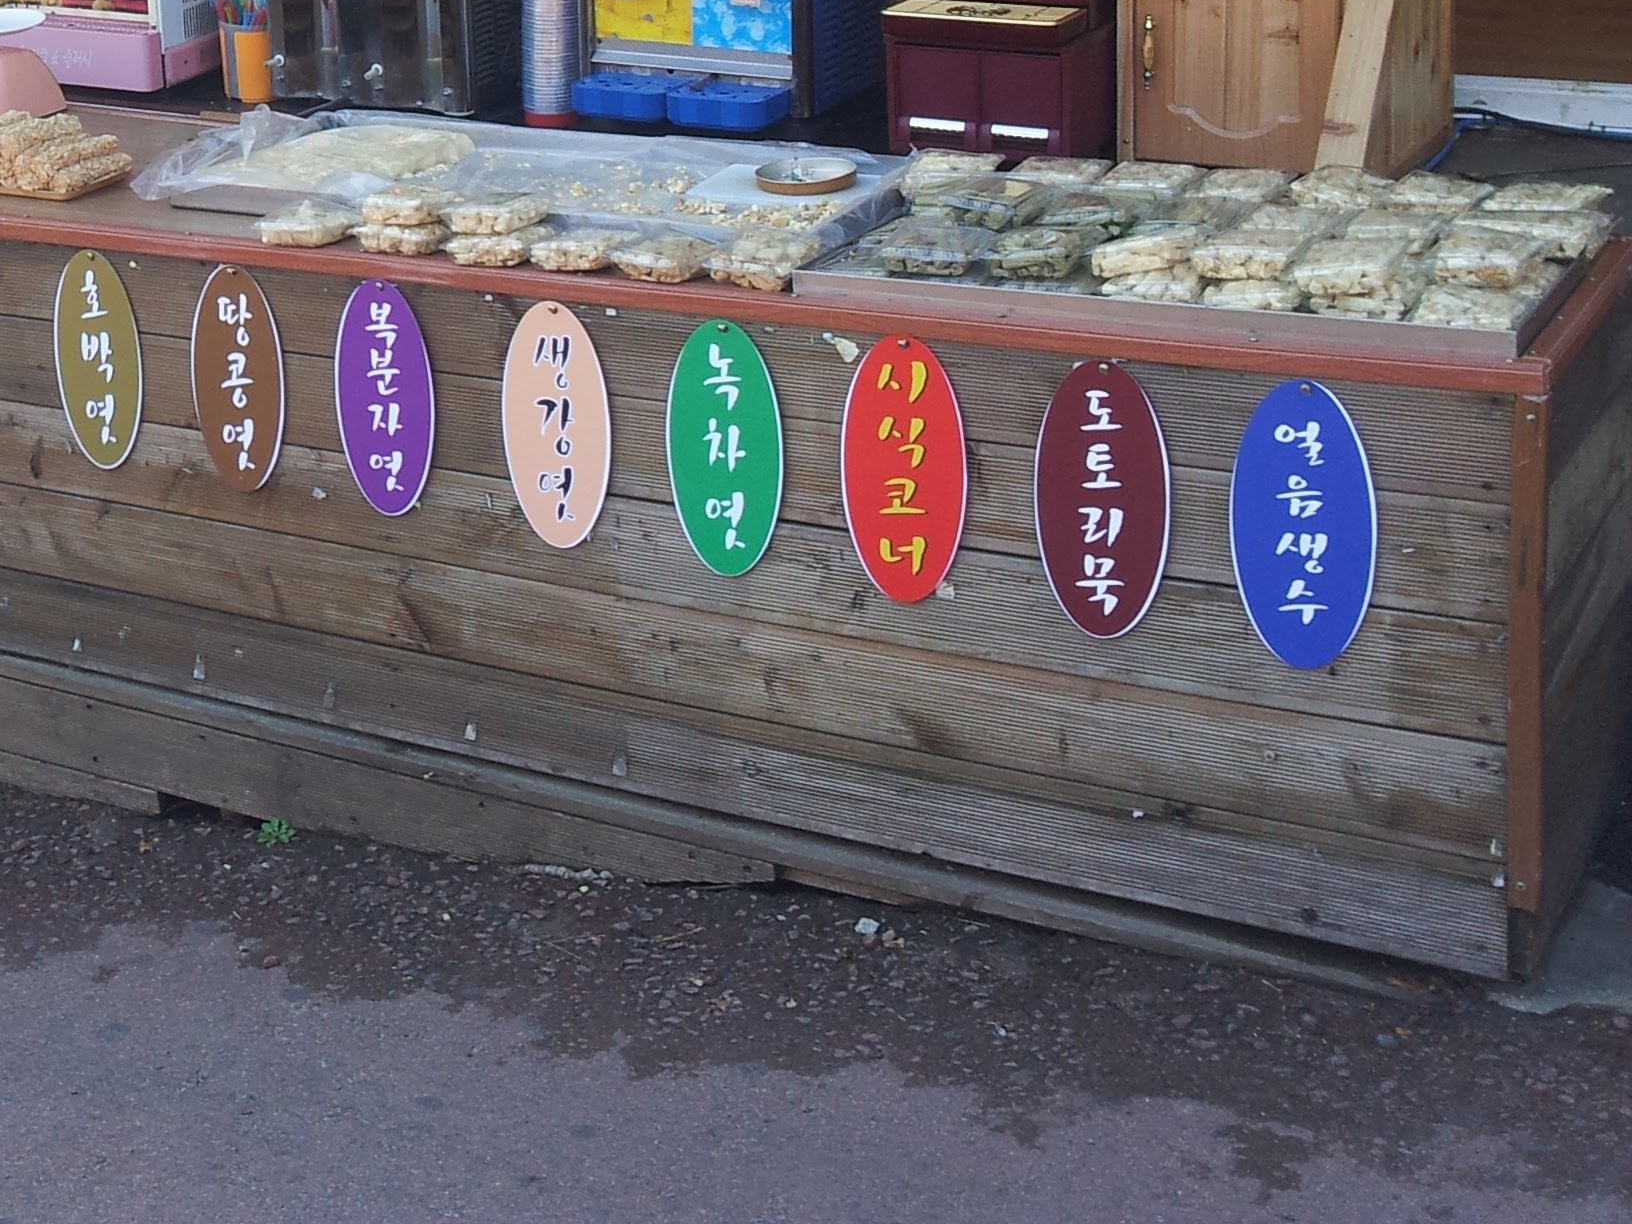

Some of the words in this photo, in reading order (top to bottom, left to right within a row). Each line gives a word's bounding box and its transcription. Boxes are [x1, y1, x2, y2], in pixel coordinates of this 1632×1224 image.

[80, 269, 117, 446] 호박엿
[217, 293, 256, 472] 땅콩엿
[365, 302, 404, 492] 복분자엿
[534, 334, 576, 522] 생강엿
[703, 343, 746, 551] 녹차엿
[878, 361, 929, 577] 시식코너
[1074, 389, 1125, 617] 도토리묵
[1274, 421, 1329, 625] 얼음생수
